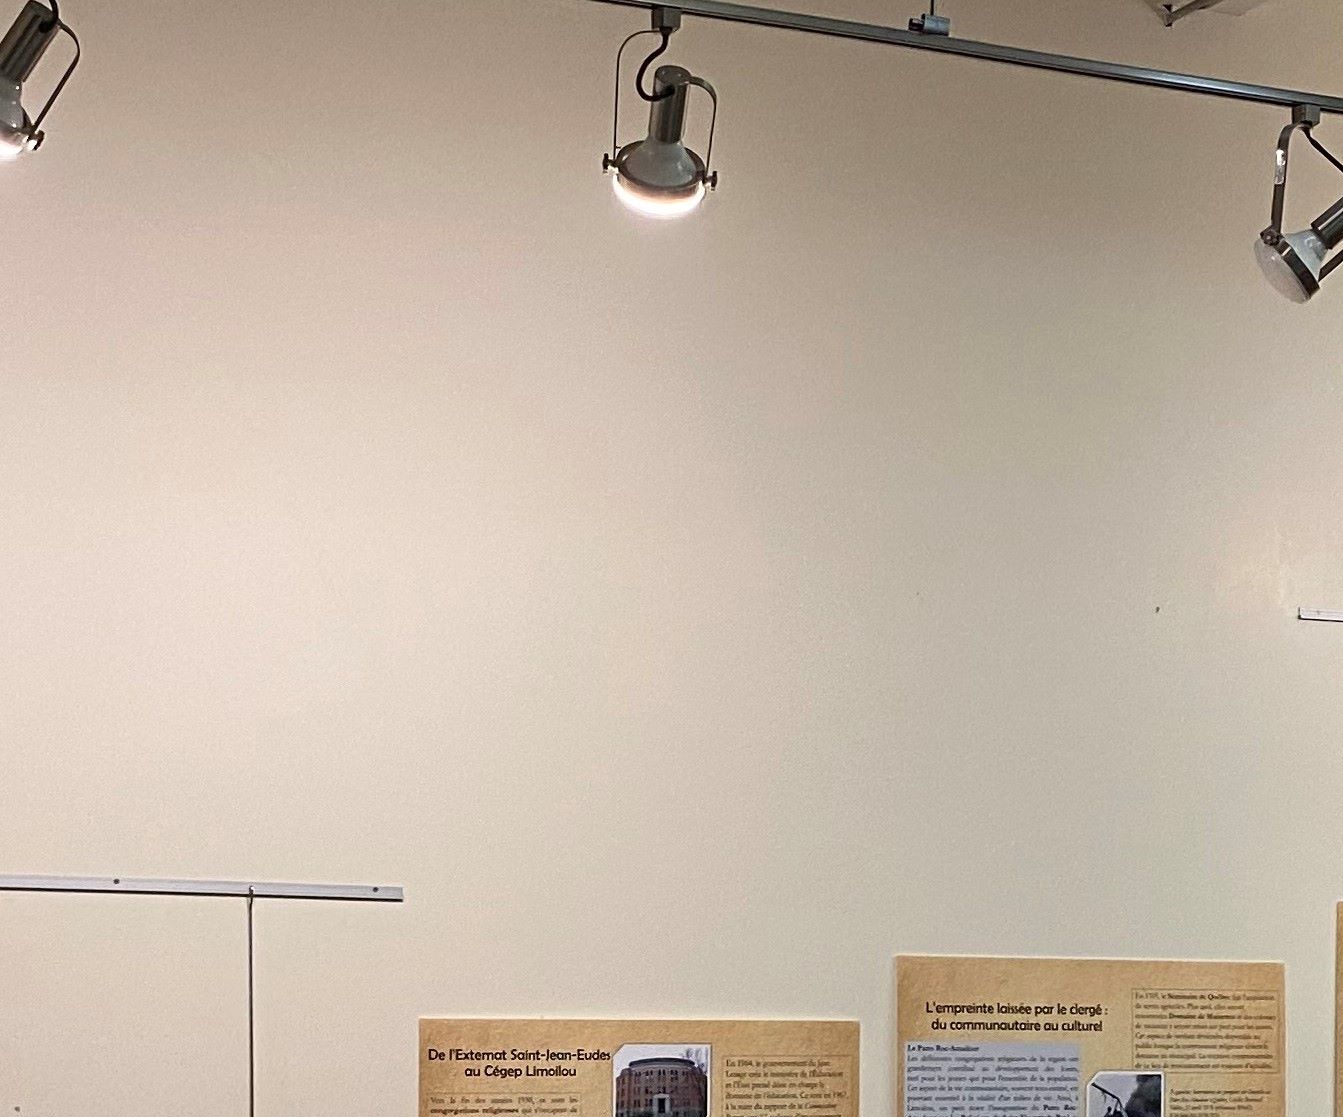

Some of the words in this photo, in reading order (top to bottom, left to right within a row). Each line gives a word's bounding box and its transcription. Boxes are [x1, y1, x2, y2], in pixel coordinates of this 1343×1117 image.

[926, 1002, 994, 1016] L'empreinte
[997, 1002, 1032, 1014] laissée
[1035, 1005, 1054, 1016] par
[1057, 1003, 1067, 1014] le
[1070, 1003, 1102, 1016] clergé
[931, 1019, 947, 1030] du
[950, 1020, 1040, 1031] communautaire
[1044, 1021, 1058, 1031] au
[1062, 1020, 1102, 1031] culturel
[428, 1049, 446, 1061] De
[449, 1048, 506, 1061] l'Externat
[510, 1048, 611, 1061] Saint-Jean-Eudes
[464, 1067, 481, 1077] au
[484, 1064, 522, 1079] Cégep
[526, 1065, 577, 1077] Limoilou
